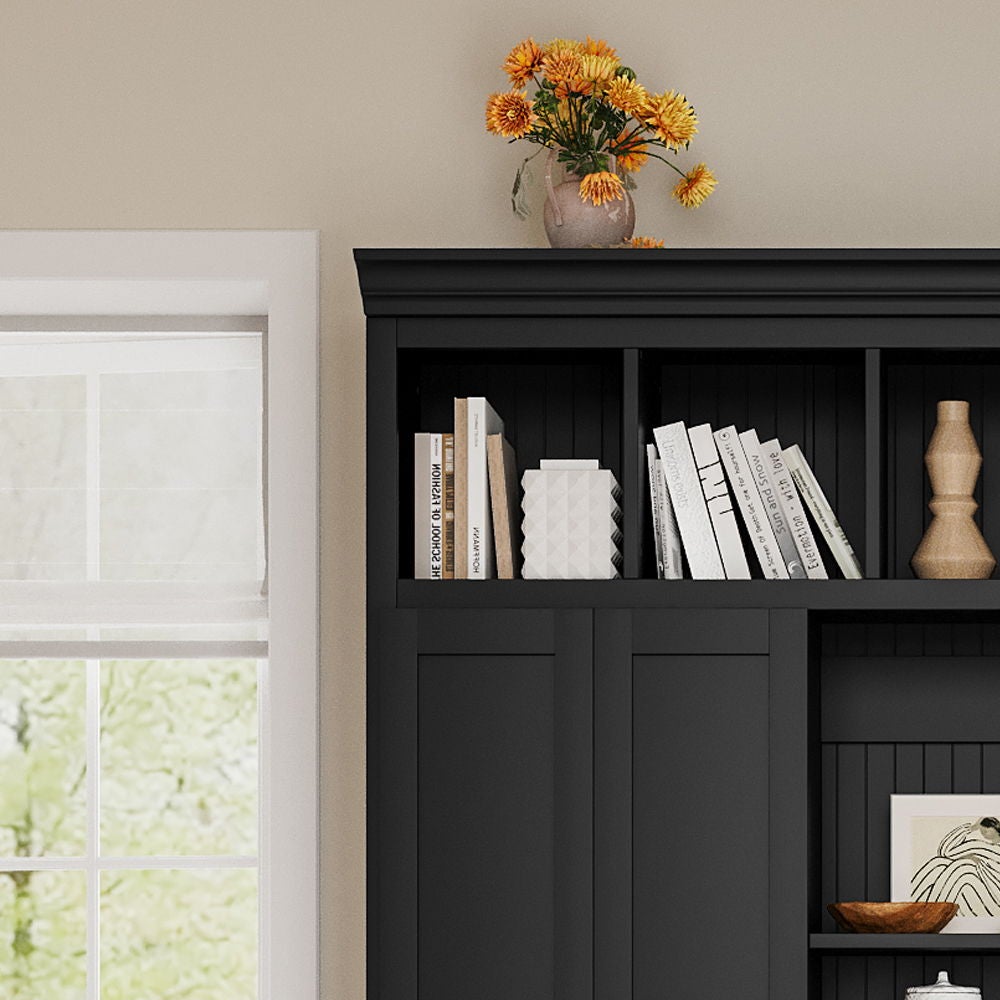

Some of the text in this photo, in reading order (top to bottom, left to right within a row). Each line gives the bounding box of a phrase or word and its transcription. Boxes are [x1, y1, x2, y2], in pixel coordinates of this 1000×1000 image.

[769, 451, 783, 475] love
[752, 453, 785, 535] Sun and Snow
[779, 478, 793, 502] with
[793, 514, 818, 570] Evermotion
